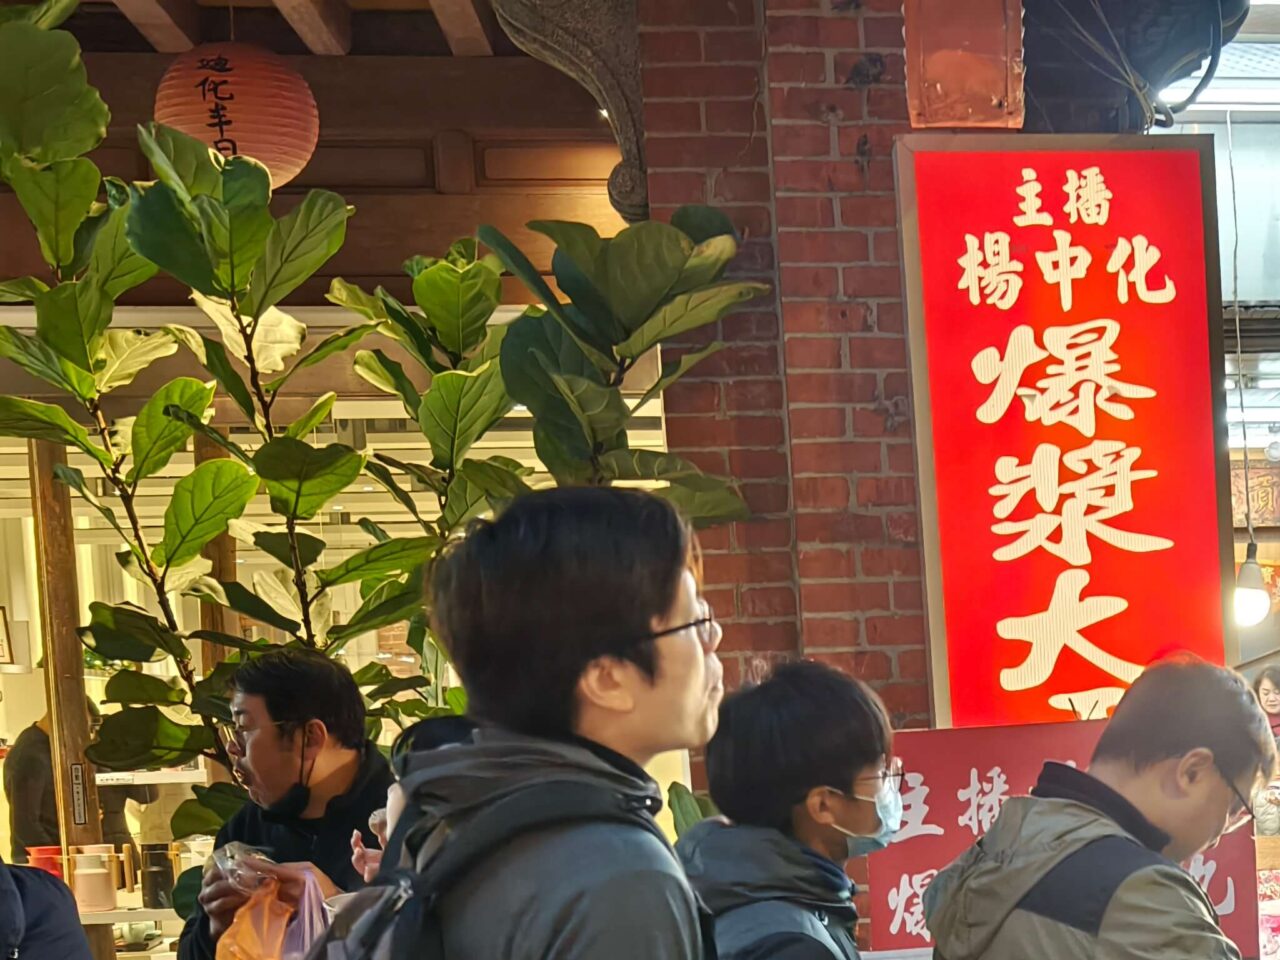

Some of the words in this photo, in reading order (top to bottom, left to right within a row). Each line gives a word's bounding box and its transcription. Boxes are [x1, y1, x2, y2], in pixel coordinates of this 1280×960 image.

[1011, 165, 1114, 228] 主播
[956, 229, 1177, 312] 楊中化
